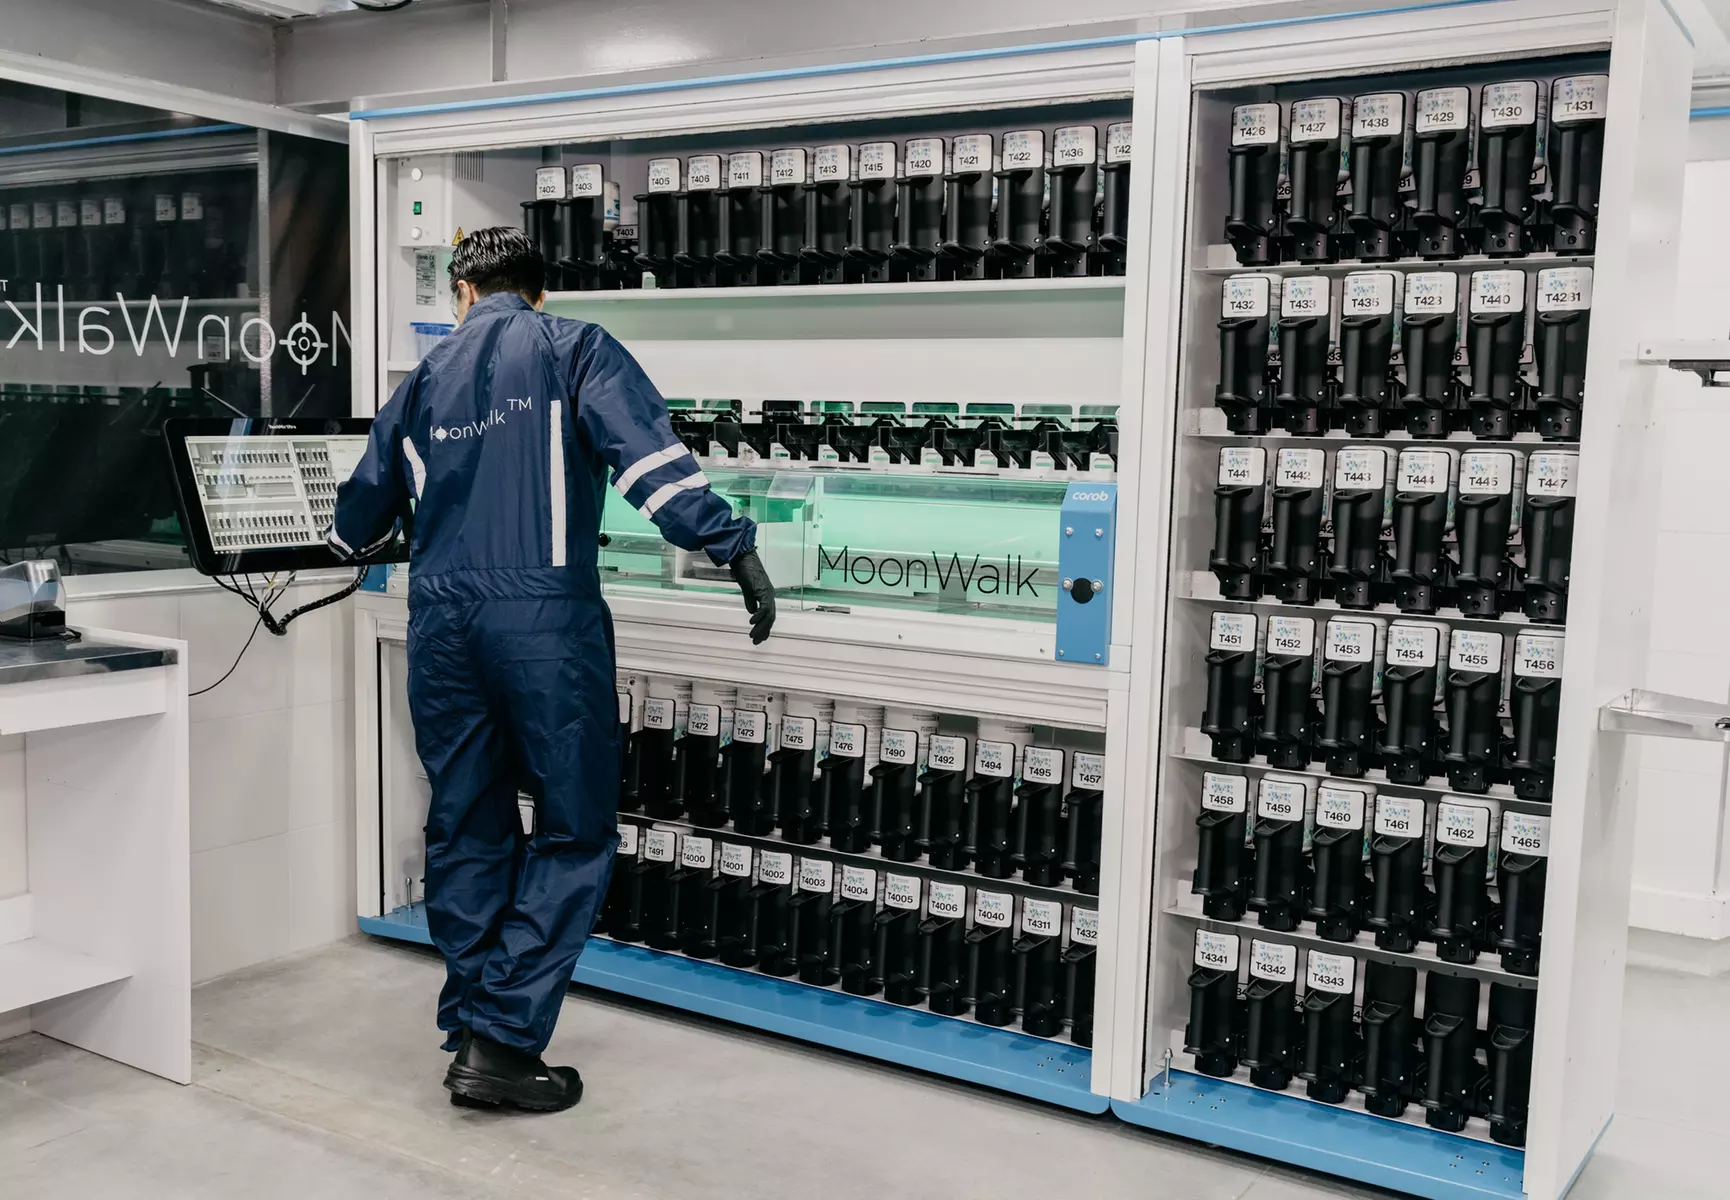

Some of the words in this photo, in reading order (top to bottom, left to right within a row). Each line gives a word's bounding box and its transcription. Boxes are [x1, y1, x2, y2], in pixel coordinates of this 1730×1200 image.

[1565, 101, 1594, 112] T431
[1426, 112, 1454, 123] T429
[1491, 107, 1522, 118] T430
[1300, 123, 1326, 134] T427
[1361, 118, 1389, 129] T438
[1240, 127, 1266, 137] T426
[1060, 148, 1084, 158] T436
[1113, 145, 1131, 155] T42
[959, 155, 979, 166] T421
[1009, 152, 1031, 162] T422
[818, 164, 837, 175] T413
[864, 163, 883, 173] T415
[910, 159, 932, 169] T420
[733, 171, 750, 181] T411
[775, 168, 794, 178] T412
[651, 177, 670, 186] T405
[690, 174, 710, 184] T406
[575, 182, 593, 192] T403
[616, 228, 634, 237] T403
[1480, 295, 1510, 304] T440
[1230, 301, 1255, 310] T432
[506, 397, 532, 411] TM
[1072, 490, 1109, 502] corob
[817, 544, 1039, 598] MoonWalk
[1219, 634, 1242, 644] T451
[1275, 638, 1301, 648] T452
[1334, 644, 1360, 654] T453
[1396, 649, 1424, 659] T454
[1459, 654, 1488, 665] T455
[1524, 659, 1555, 670] T456
[648, 715, 662, 724] T471
[692, 722, 708, 731] T472
[737, 727, 754, 737] T473
[785, 735, 803, 744] T475
[834, 741, 853, 751] T476
[885, 747, 905, 757] T490
[934, 755, 954, 764] T492
[980, 760, 1002, 770] T494
[1029, 766, 1051, 777] T495
[1079, 773, 1101, 784] T457
[1209, 794, 1234, 805] T458
[1265, 802, 1291, 813] T459
[1324, 811, 1350, 822] T460
[1384, 819, 1409, 830] T461
[1446, 827, 1474, 839] T462
[1511, 836, 1540, 848] T465
[648, 847, 664, 856] T491
[683, 853, 705, 863] T4000
[722, 860, 744, 871] T4001
[761, 868, 784, 879] T4002
[802, 875, 825, 887] T4003
[844, 883, 868, 895] T4004
[888, 891, 913, 903] T4005
[931, 900, 957, 912] T4006
[978, 909, 1004, 921] T4040
[1028, 918, 1050, 930] T4311
[1200, 951, 1228, 964] T4341
[1256, 962, 1286, 975] T4342
[1313, 973, 1344, 986] T4343
